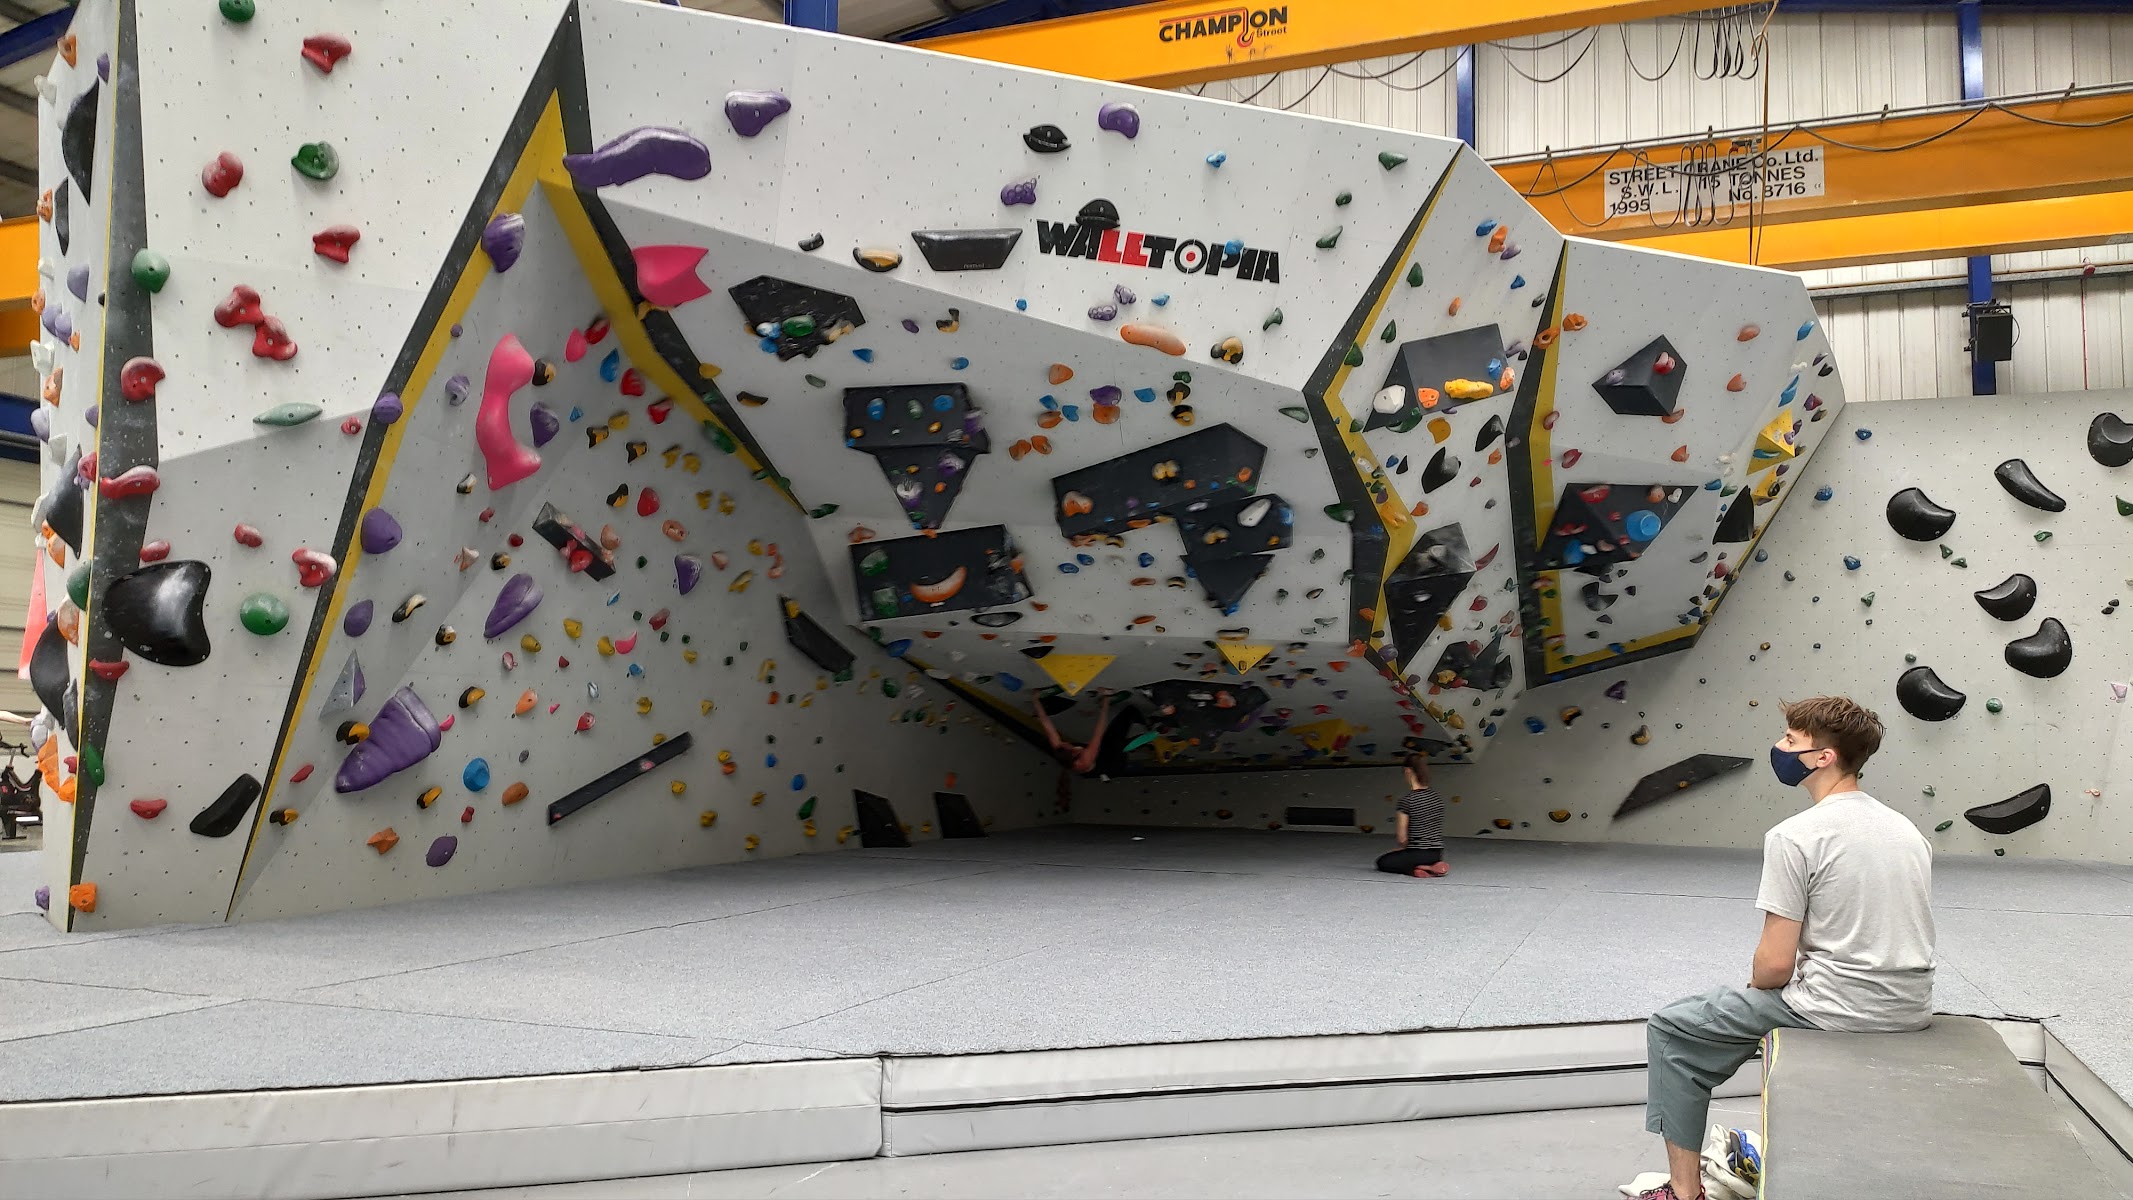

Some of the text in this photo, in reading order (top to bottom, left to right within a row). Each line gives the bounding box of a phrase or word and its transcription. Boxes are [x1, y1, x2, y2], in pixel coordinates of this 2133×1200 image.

[1159, 6, 1288, 44] CHAMPION
[1256, 27, 1287, 39] Street
[1609, 164, 1679, 185] STREET
[1684, 157, 1747, 175] CRANE
[1699, 174, 1721, 190] 15
[1730, 166, 1806, 186] TONNES
[1609, 198, 1650, 215] 1995
[1729, 187, 1758, 202] No.
[1036, 218, 1280, 284] WALLTOPIA
